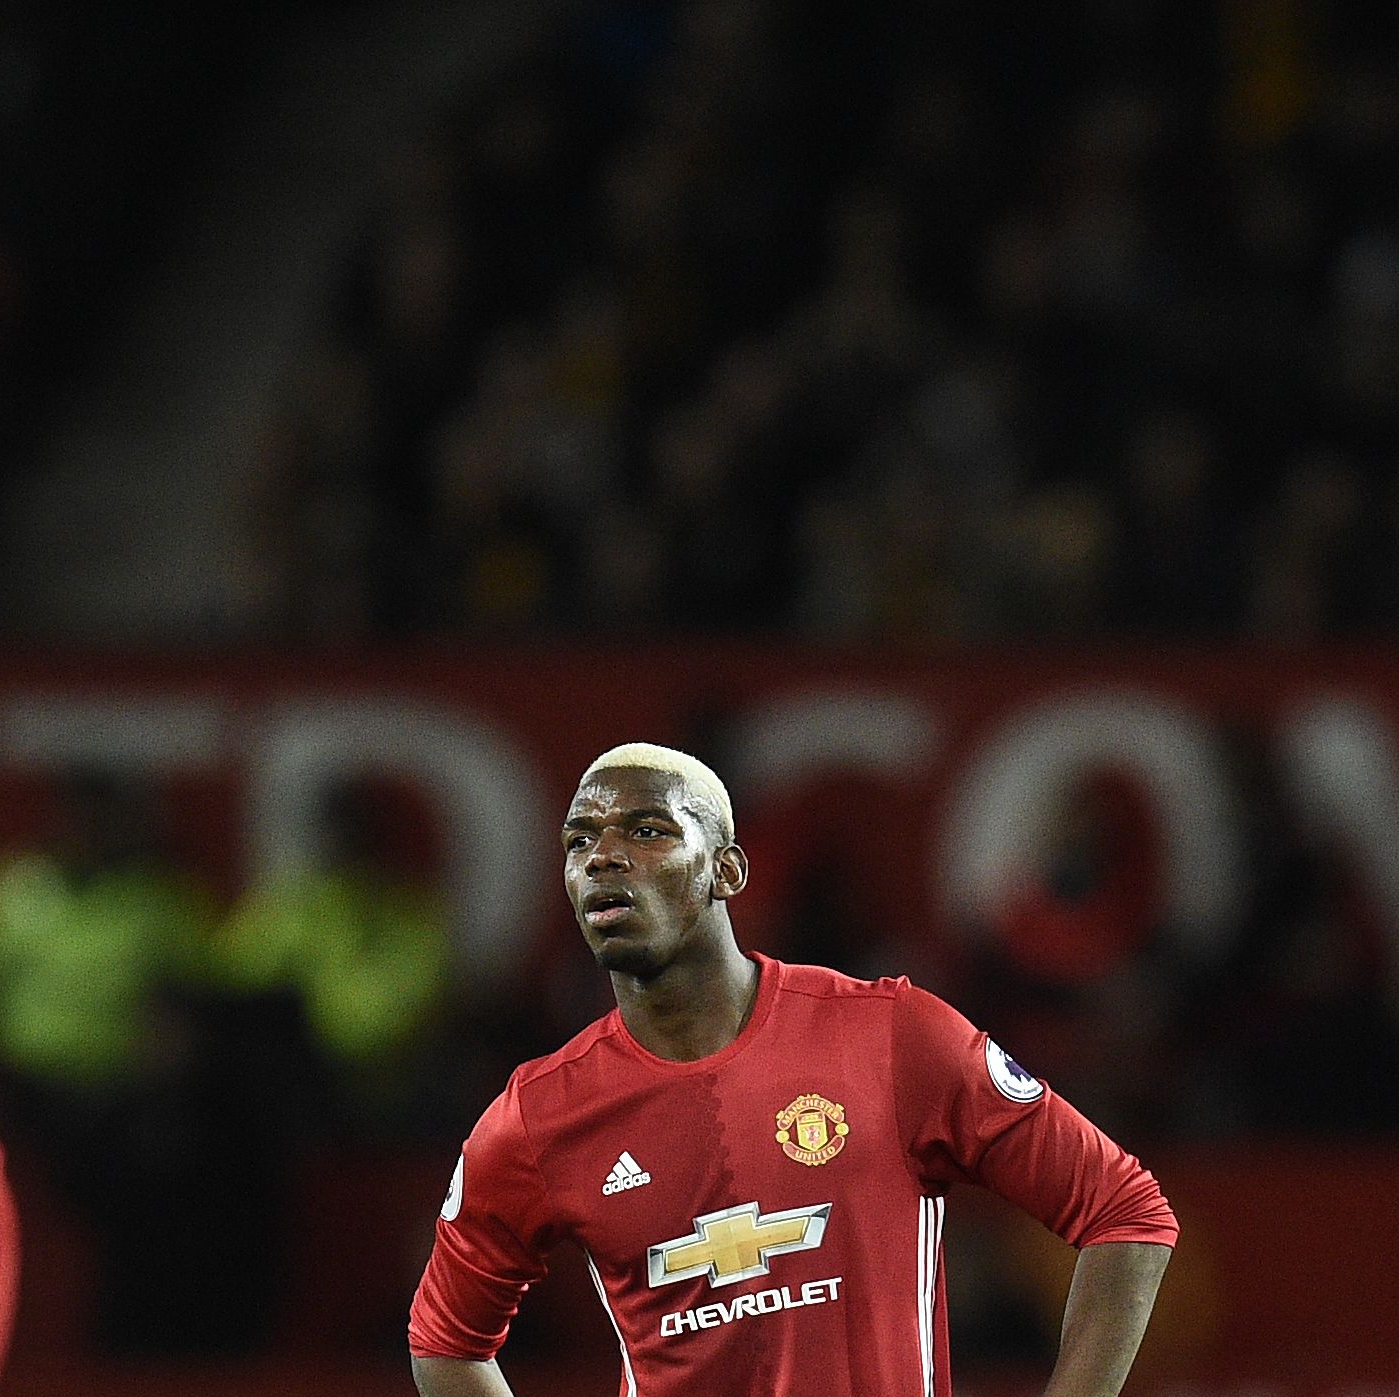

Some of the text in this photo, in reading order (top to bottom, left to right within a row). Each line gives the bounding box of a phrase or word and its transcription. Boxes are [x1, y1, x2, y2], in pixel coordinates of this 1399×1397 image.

[782, 1099, 840, 1125] MANCHESTER
[794, 1145, 836, 1161] UNITED
[602, 1171, 651, 1196] adidas
[660, 1276, 843, 1337] CHEVROLET
